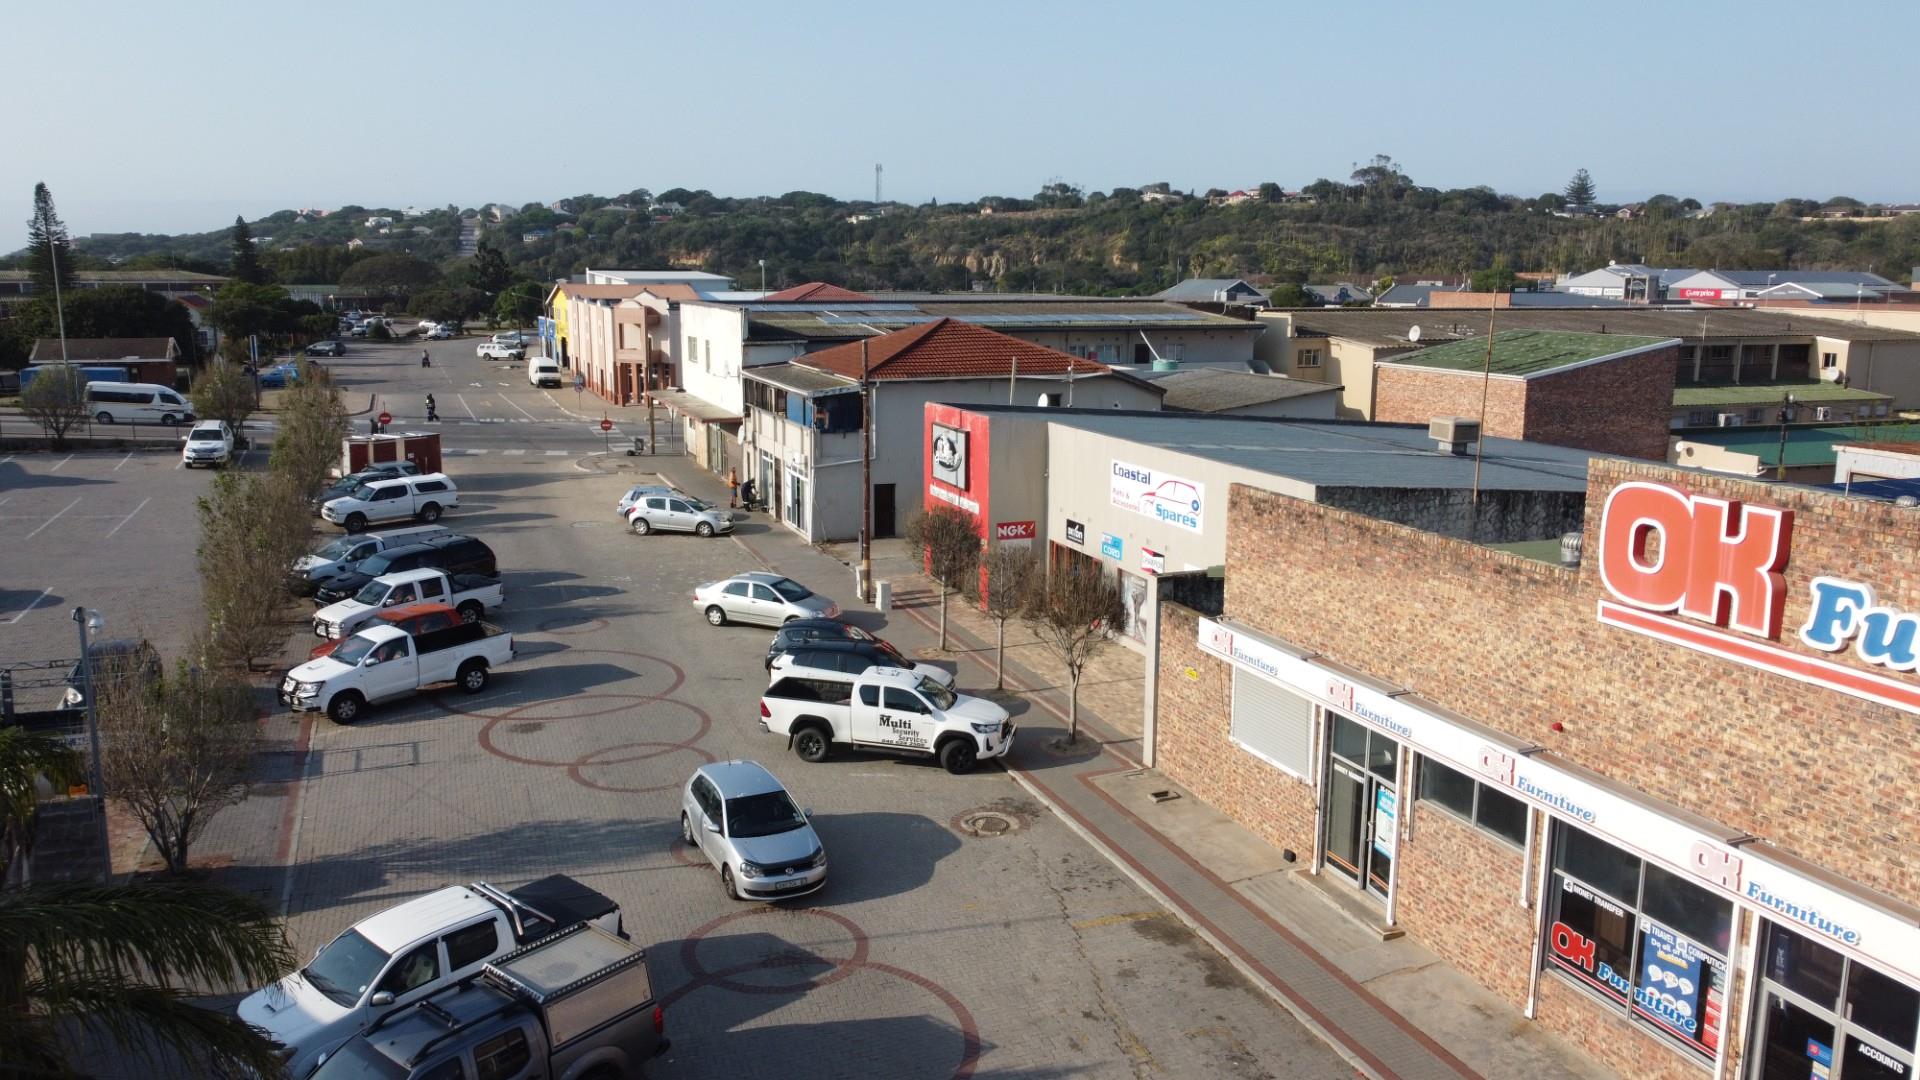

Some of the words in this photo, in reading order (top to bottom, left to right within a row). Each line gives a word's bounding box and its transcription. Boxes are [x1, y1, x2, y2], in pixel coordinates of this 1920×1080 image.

[1113, 463, 1151, 485] Coastal
[996, 524, 1026, 538] NGK
[1155, 503, 1197, 528] Spares
[1599, 481, 1791, 639] OK
[1211, 627, 1234, 656] OK
[1234, 647, 1278, 676] Furniture
[879, 714, 912, 730] Multi
[1327, 678, 1354, 711] OK
[1355, 702, 1412, 737] Furniture
[892, 727, 920, 737] Security
[898, 734, 928, 744] Services
[1479, 745, 1516, 786] OK
[1516, 775, 1596, 823] Furniture
[1573, 884, 1594, 904] MONEY
[1593, 895, 1625, 918] TRANSFER
[1689, 840, 1743, 892] OK
[1746, 880, 1861, 946] Furniture
[1651, 926, 1675, 946] TRAVEL
[1551, 921, 1596, 973] OK
[1597, 961, 1698, 1033] Furniture
[1858, 1043, 1904, 1074] ACCOUNTS
